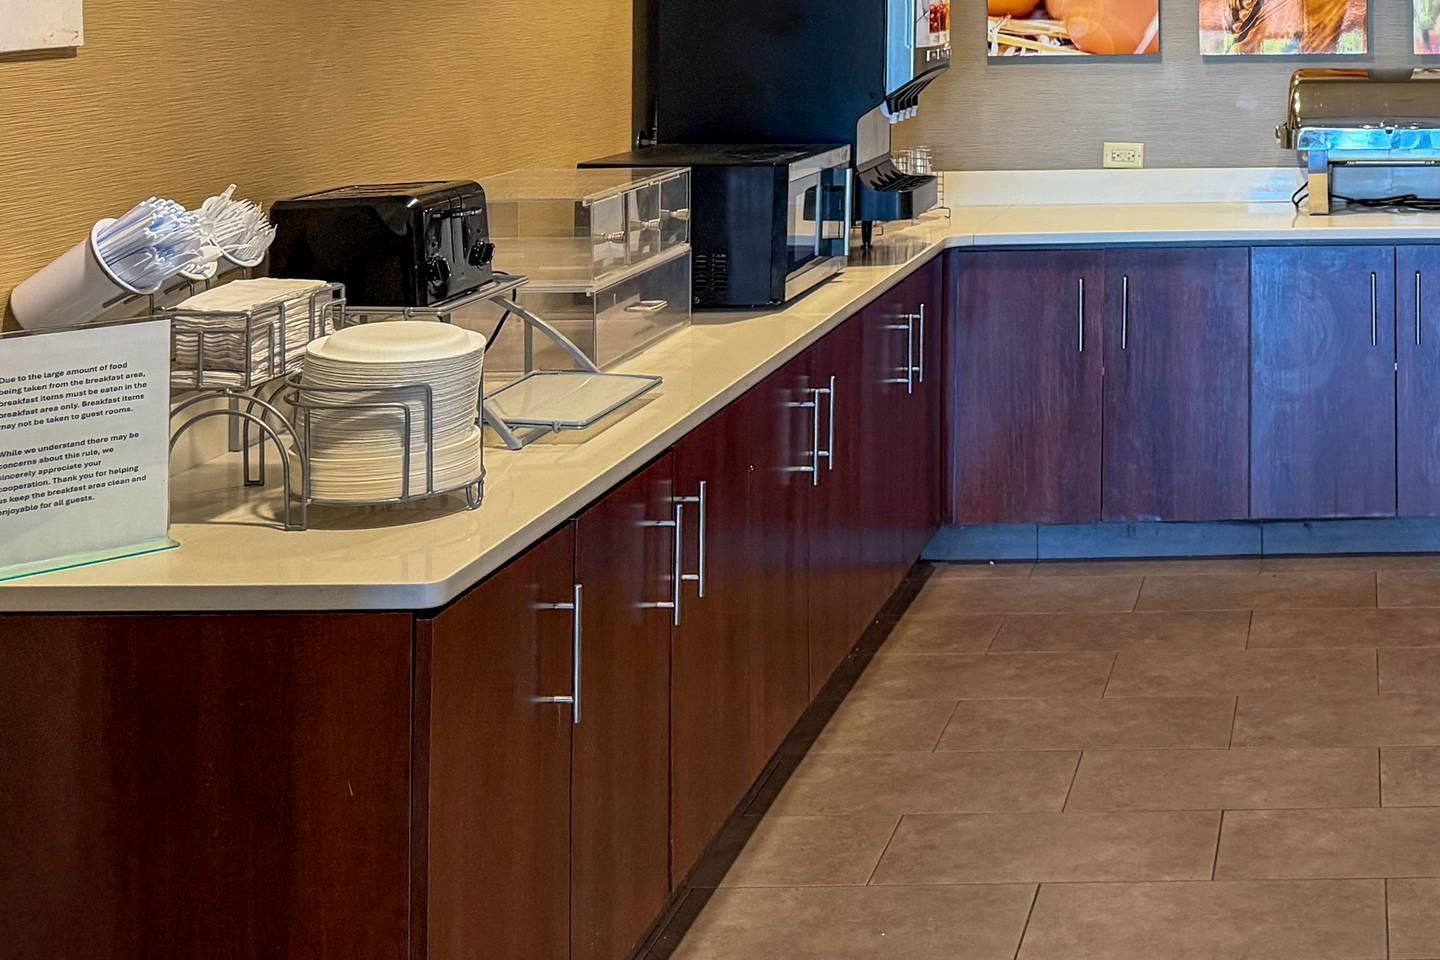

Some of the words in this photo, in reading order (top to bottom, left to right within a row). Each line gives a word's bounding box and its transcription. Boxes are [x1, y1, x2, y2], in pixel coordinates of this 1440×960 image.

[66, 366, 98, 375] amount
[109, 362, 127, 370] food
[24, 384, 47, 392] taken
[86, 374, 124, 384] breakfast
[61, 403, 80, 411] only.
[82, 397, 120, 407] Breakfast
[81, 410, 103, 419] guest
[105, 407, 133, 415] rooms.
[38, 440, 85, 452] understand
[111, 434, 127, 442] may
[39, 455, 63, 463] about
[38, 464, 82, 475] appreciate
[52, 475, 77, 484] Thank
[79, 473, 94, 481] you
[109, 465, 139, 475] helping
[9, 494, 30, 502] keep
[47, 485, 86, 496] breakfast
[107, 478, 130, 487] clean
[65, 495, 95, 506] guests.
